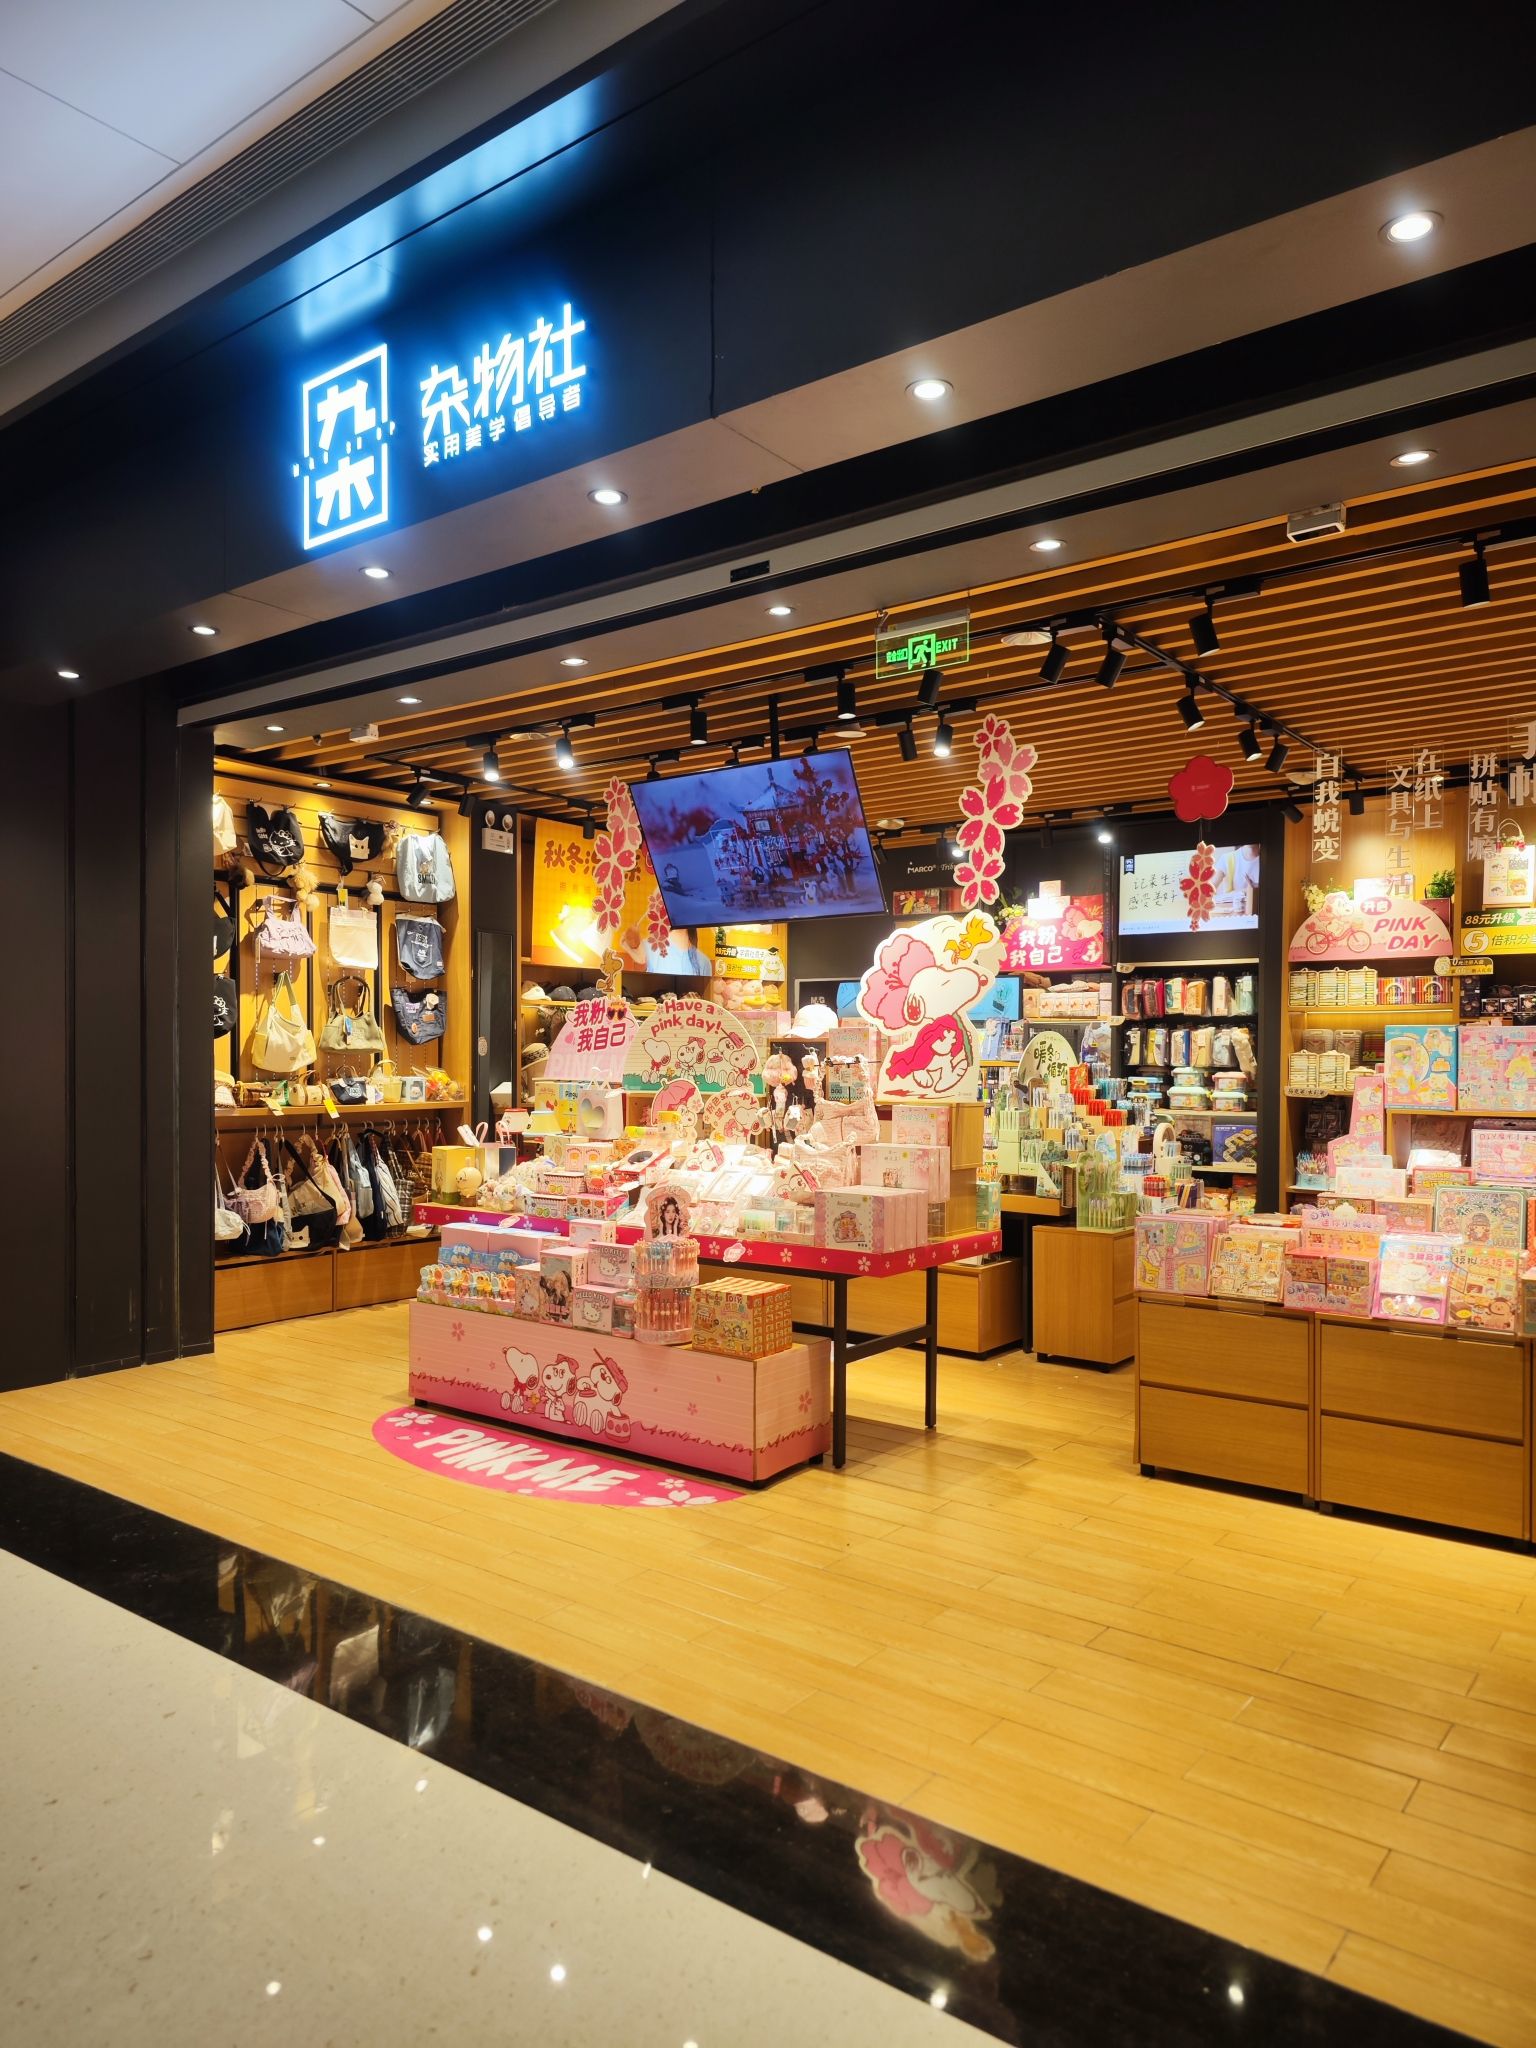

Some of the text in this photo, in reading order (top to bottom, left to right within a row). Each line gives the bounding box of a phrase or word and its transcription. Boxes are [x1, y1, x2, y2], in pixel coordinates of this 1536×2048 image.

[420, 302, 587, 447] 杂物社
[423, 384, 582, 468] 实用美学倡导者
[935, 637, 959, 653] EXIT
[1414, 748, 1442, 829] 在纸上
[1313, 753, 1340, 862] 自我蜕变
[1470, 752, 1499, 861] 拼贴有瘾
[1363, 902, 1389, 913] 开启
[1465, 912, 1516, 925] 88元升级
[1373, 915, 1431, 933] PINK
[1019, 925, 1057, 948] 我粉
[1388, 934, 1438, 951] DAY
[1469, 932, 1485, 951] 5
[1010, 946, 1063, 968] 我自己
[574, 1001, 606, 1028] 我粉
[665, 999, 715, 1014] Have a
[650, 1014, 722, 1037] pink day!
[577, 1023, 626, 1053] 我自己
[575, 1292, 609, 1305] HELLO KITTY
[414, 1427, 641, 1492] PINK ME
